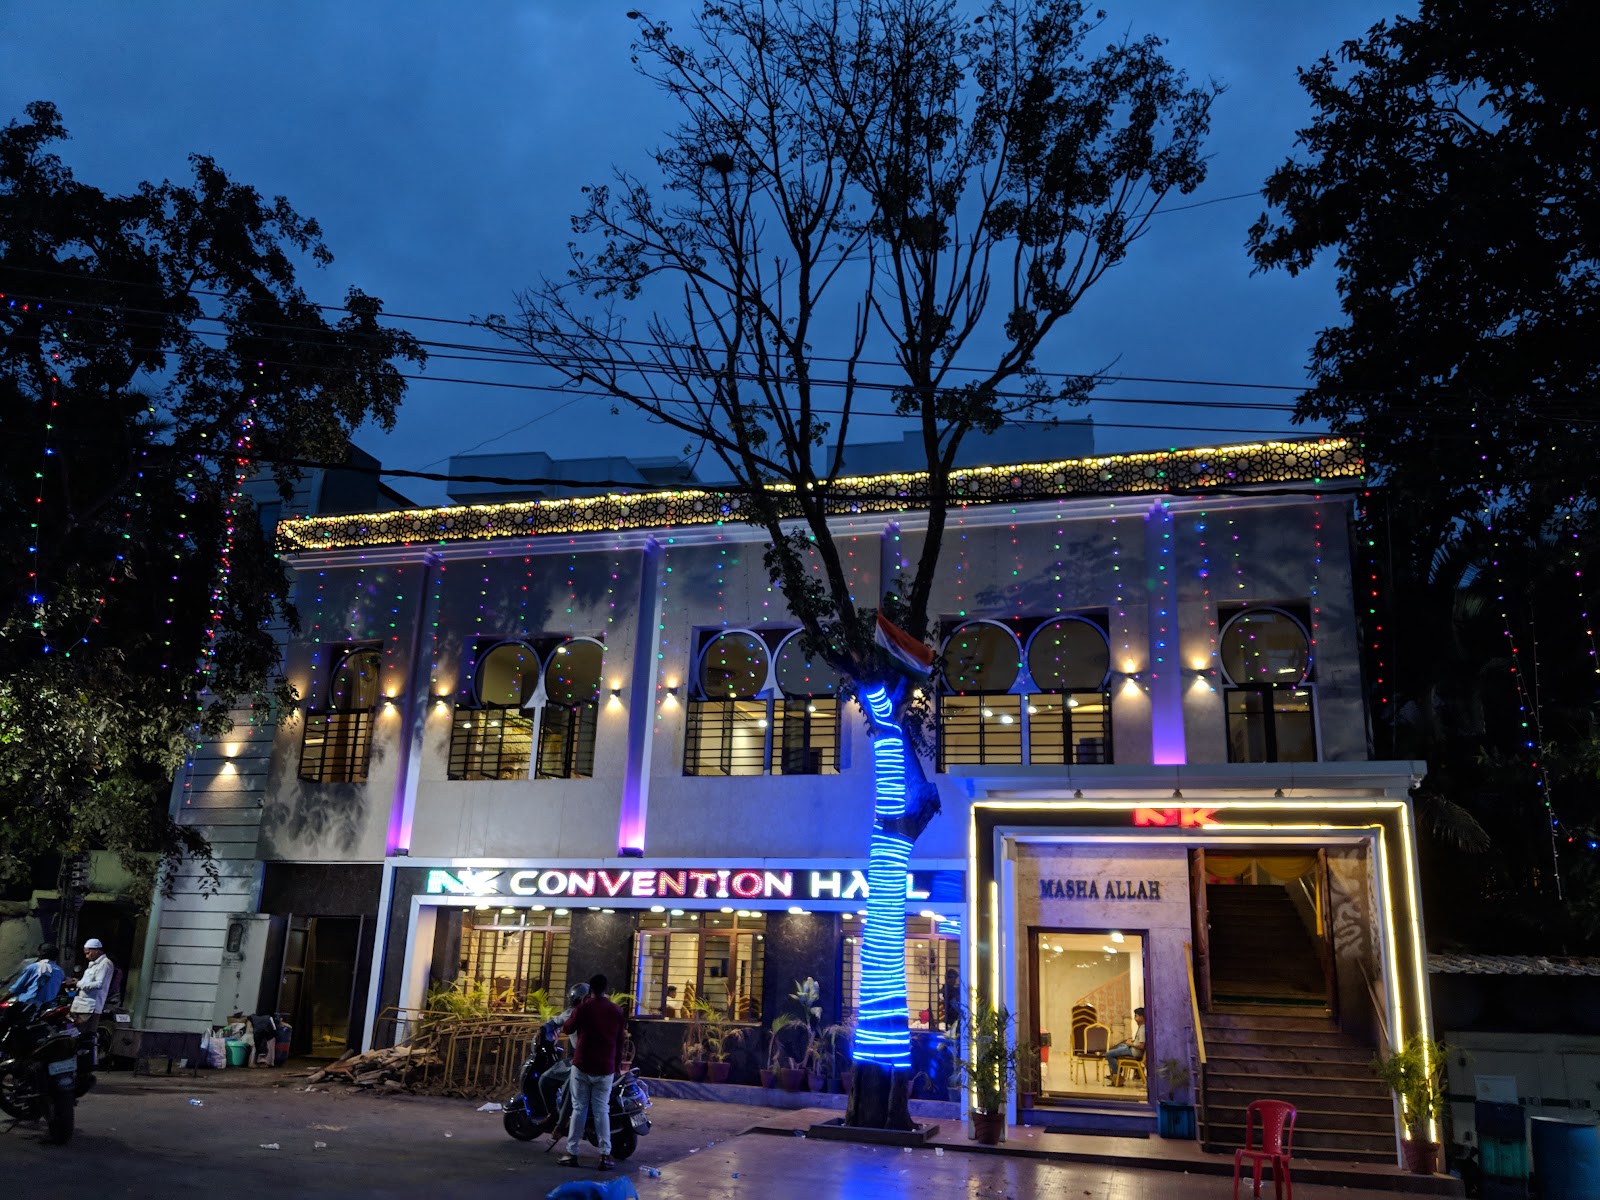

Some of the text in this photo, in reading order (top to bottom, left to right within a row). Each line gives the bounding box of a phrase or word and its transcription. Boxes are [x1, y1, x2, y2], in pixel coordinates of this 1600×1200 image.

[1133, 806, 1222, 827] NK
[509, 869, 793, 898] CONVENTION
[810, 870, 930, 899] HAL
[1040, 880, 1160, 900] MASHA ALLAH
